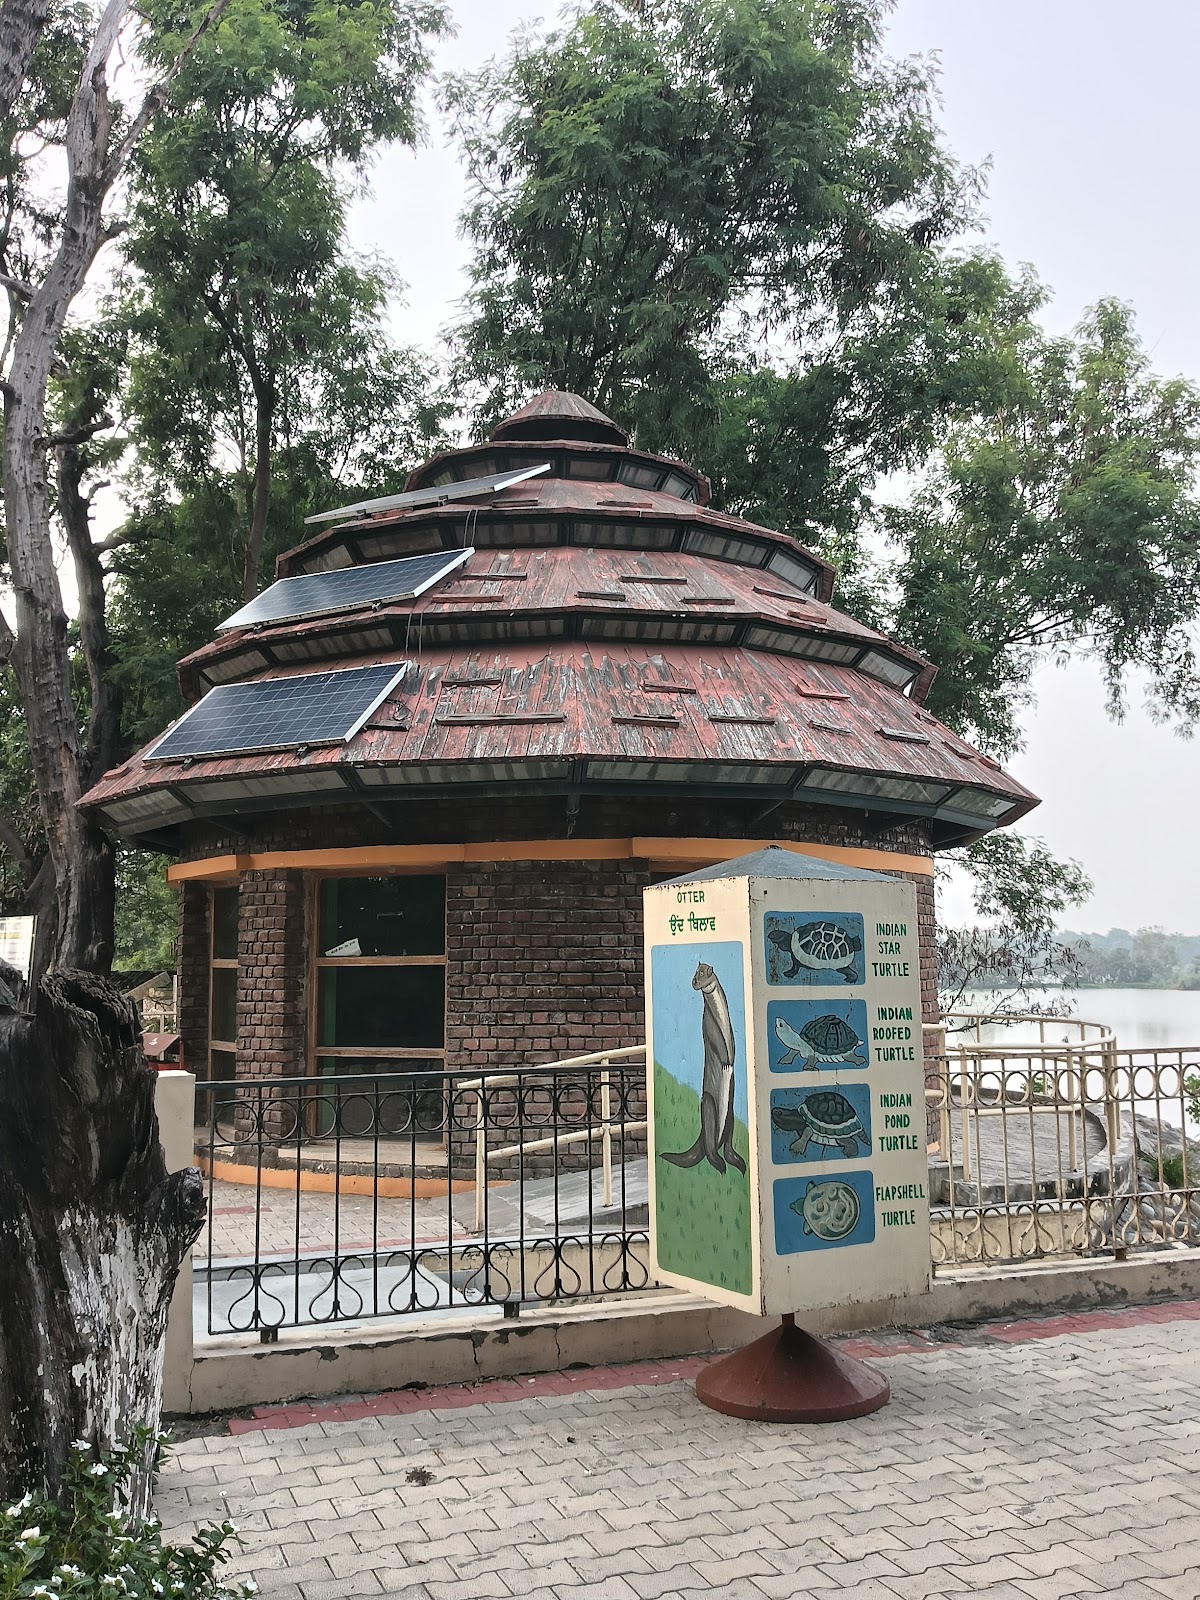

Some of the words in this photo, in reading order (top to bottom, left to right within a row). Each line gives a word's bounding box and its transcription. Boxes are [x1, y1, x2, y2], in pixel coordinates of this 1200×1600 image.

[677, 891, 704, 903] OTTER
[876, 923, 907, 936] INDIAN
[878, 941, 901, 955] STAR
[872, 962, 910, 977] TURTLE
[877, 1007, 913, 1021] INDIAN
[872, 1027, 911, 1041] ROOFED
[875, 1047, 915, 1062] TURTLE
[880, 1093, 912, 1108] INDIAN
[885, 1114, 910, 1129] POND
[879, 1135, 918, 1151] TURTLE
[876, 1184, 925, 1201] FLAPSHELL
[881, 1210, 915, 1227] TURTLE
